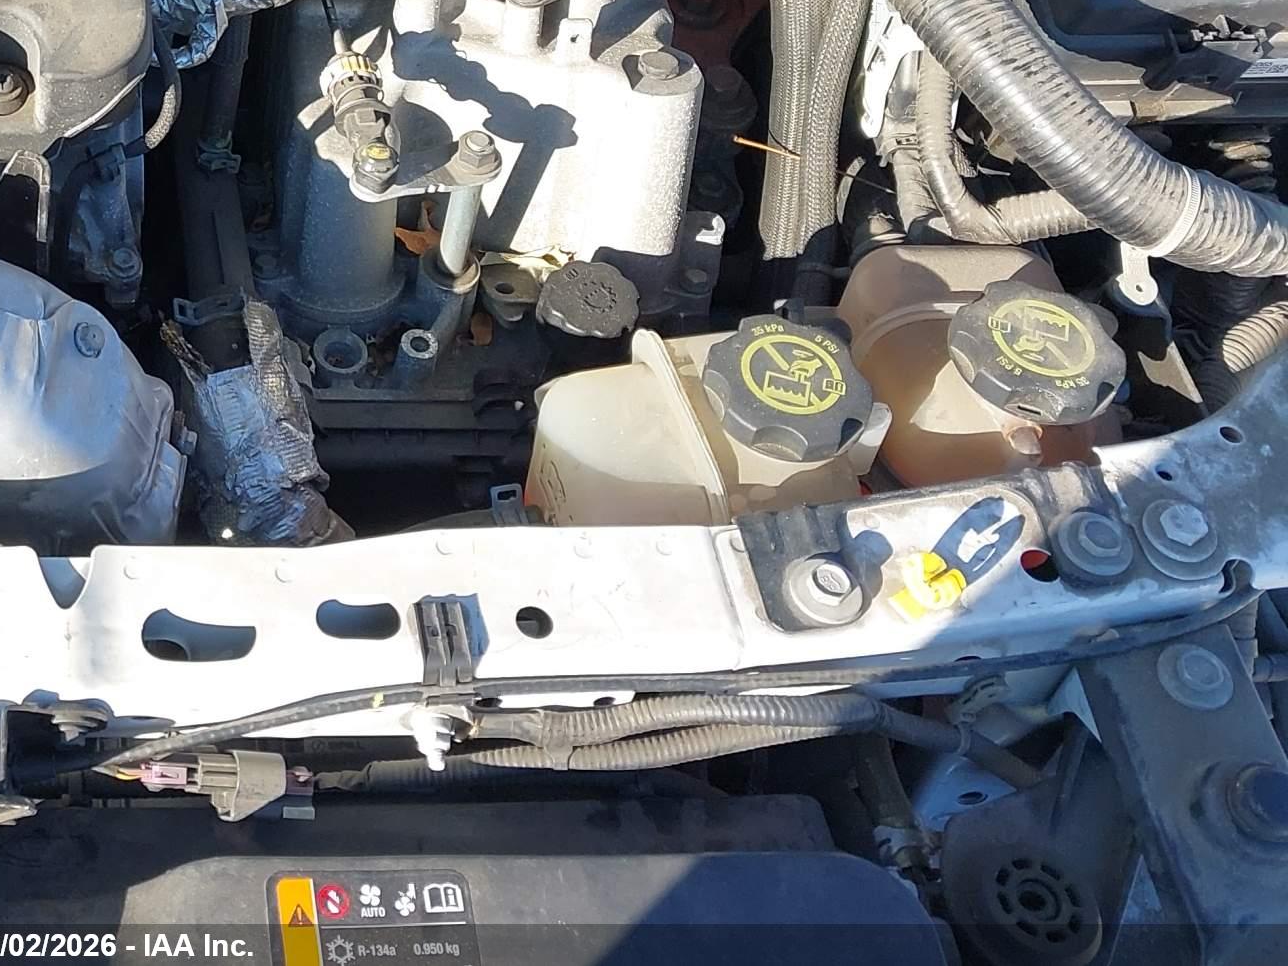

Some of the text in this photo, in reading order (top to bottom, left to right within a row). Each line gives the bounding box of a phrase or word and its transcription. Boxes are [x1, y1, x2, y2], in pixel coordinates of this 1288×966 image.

[752, 323, 785, 336] 35 kPa
[822, 339, 840, 355] PSI
[996, 355, 1014, 371] PSI
[1056, 375, 1090, 389] 35 kPa
[361, 907, 386, 918] AUTO
[358, 945, 397, 956] R-134a
[413, 941, 460, 956] 0.950 kg
